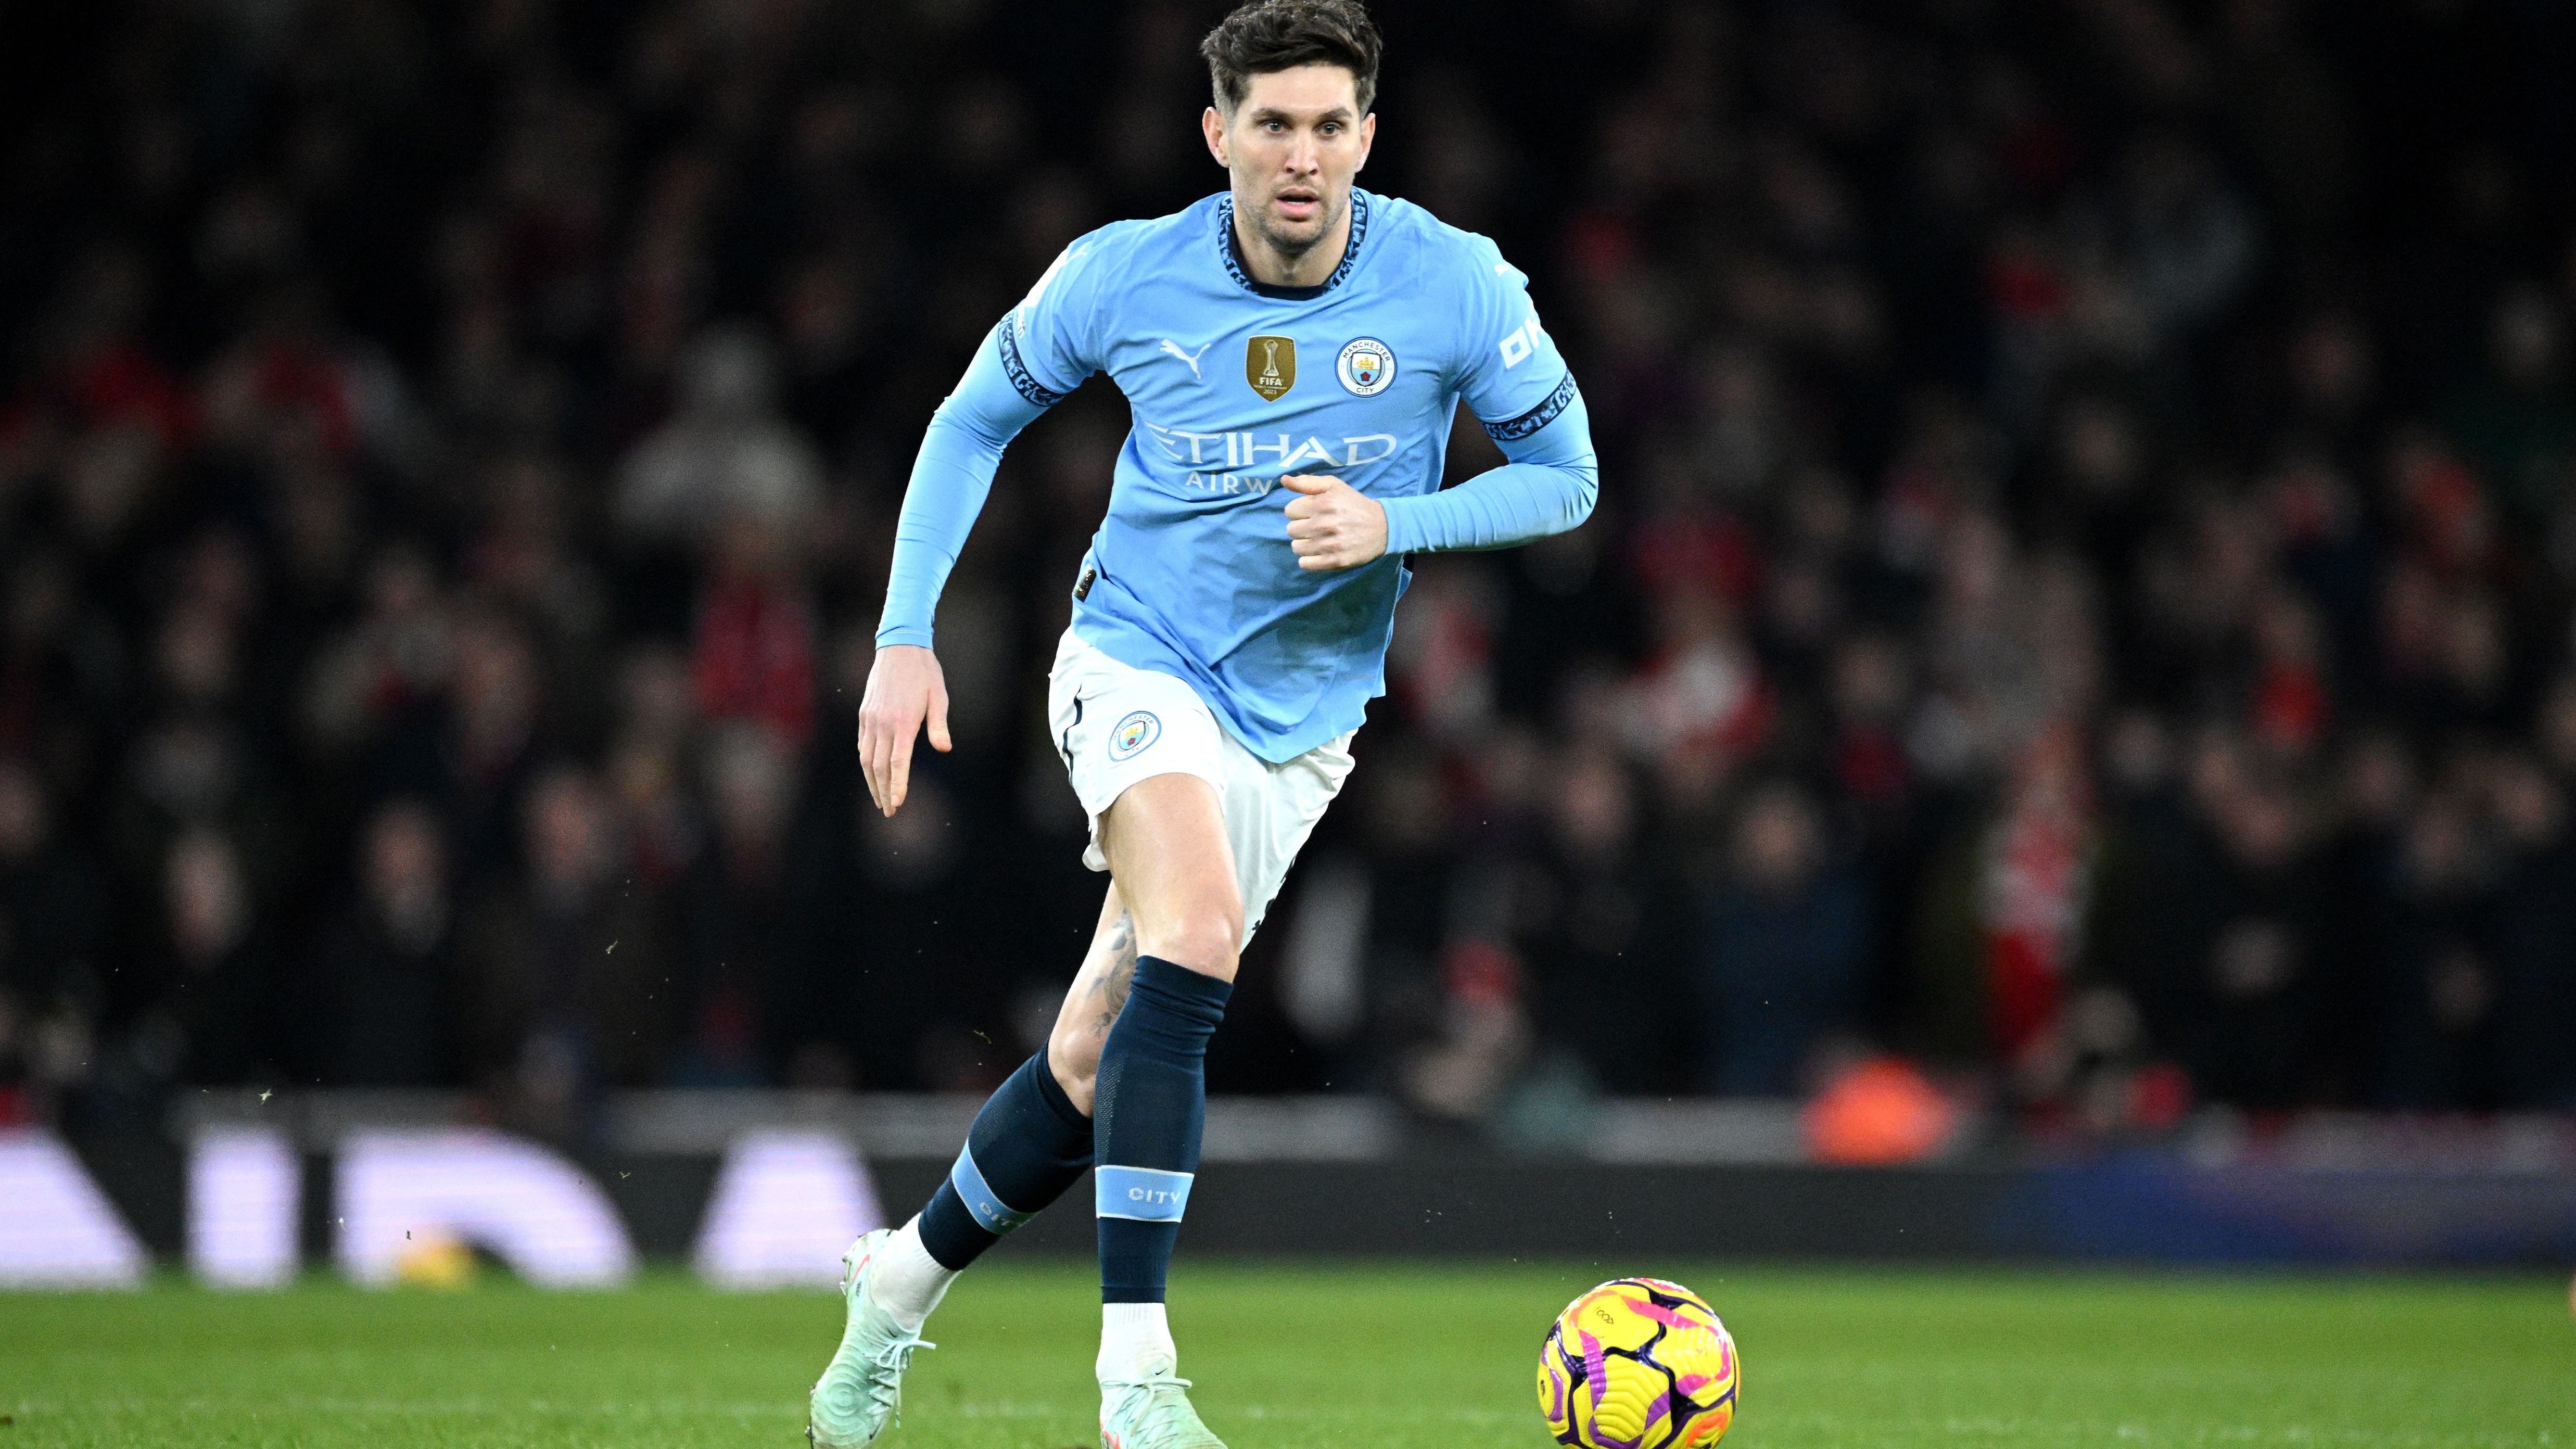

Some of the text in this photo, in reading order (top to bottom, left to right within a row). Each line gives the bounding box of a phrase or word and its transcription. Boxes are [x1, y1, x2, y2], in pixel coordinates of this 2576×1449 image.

[1342, 341, 1391, 362] MANCHESTER
[1259, 377, 1283, 386] FIFA
[1145, 422, 1398, 468] ETIHAD
[1185, 469, 1274, 495] AIRW
[1128, 1187, 1181, 1205] CITY
